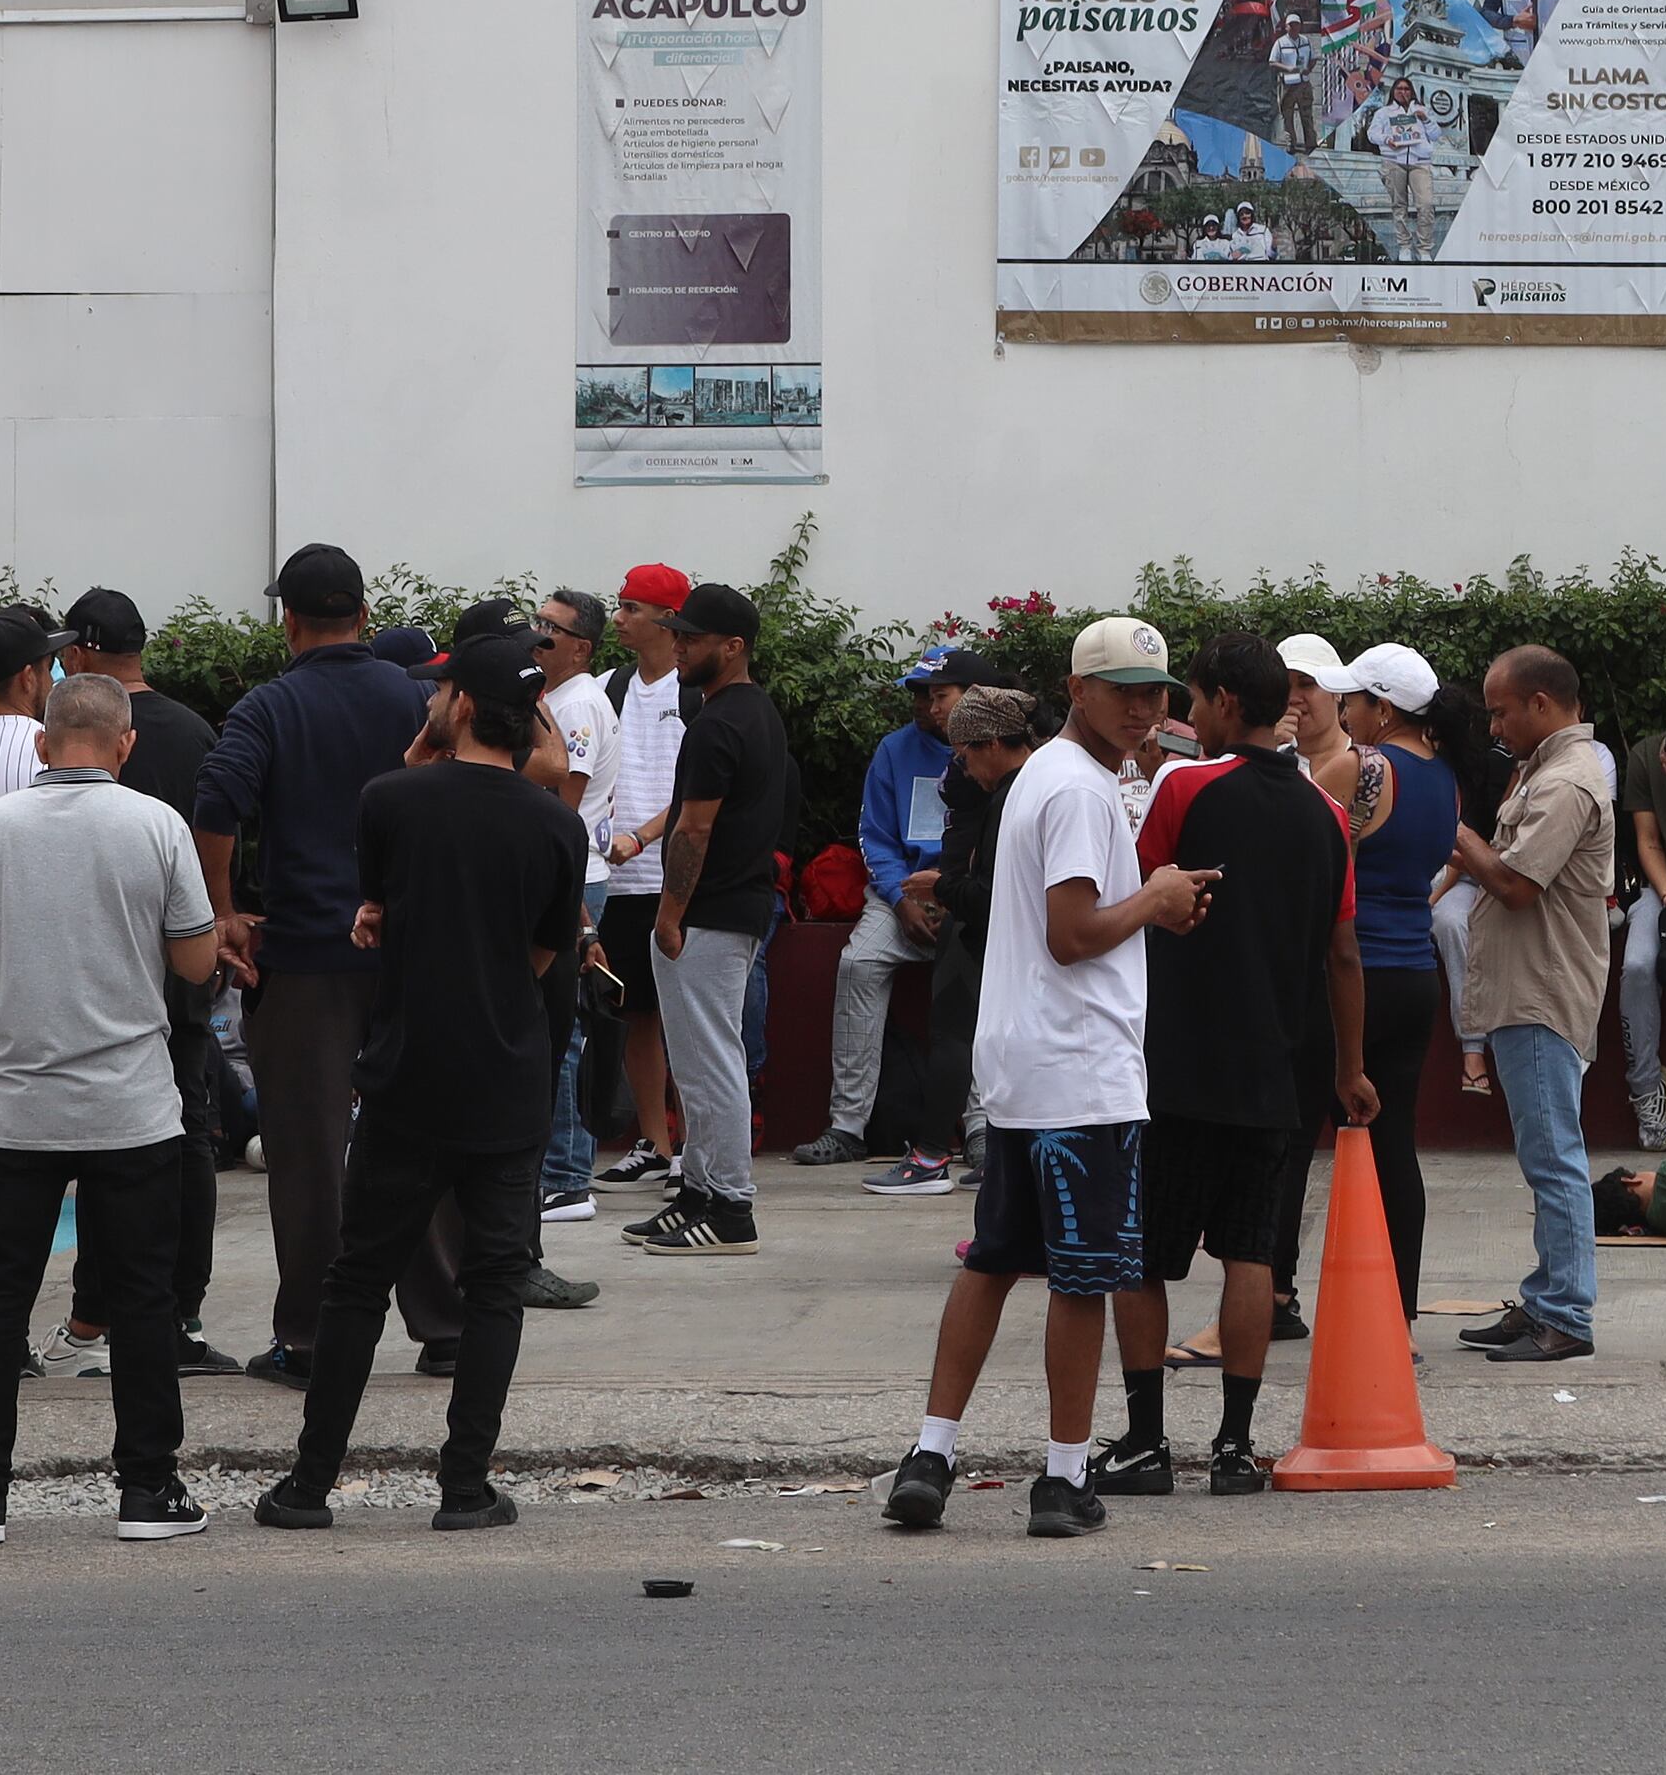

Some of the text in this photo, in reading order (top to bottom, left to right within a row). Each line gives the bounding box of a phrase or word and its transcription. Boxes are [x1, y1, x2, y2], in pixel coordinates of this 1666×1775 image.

[1607, 5, 1620, 14] de
[1015, 0, 1200, 43] paisanos
[1561, 22, 1583, 32] para
[1585, 20, 1629, 30] Trámites
[1632, 22, 1638, 32] y
[649, 30, 722, 48] aportación
[1043, 61, 1135, 76] ¿PAISANO,
[1568, 67, 1650, 86] LLAMA
[1008, 80, 1173, 93] NECESITAS AYUDA?
[633, 98, 727, 108] PUEDES DONAR:
[1546, 92, 1584, 111] SIN
[623, 117, 671, 126] Alimentos
[687, 117, 746, 127] perecederos
[623, 129, 709, 138] Agua embotellada
[1517, 134, 1562, 145] DESDE
[1565, 134, 1627, 145] ESTADOS
[668, 139, 679, 148] de
[681, 139, 716, 150] higiene
[718, 138, 759, 149] personal
[623, 150, 669, 160] Utensilios
[1527, 153, 1535, 168] 1
[1541, 153, 1578, 168] 877
[1583, 153, 1615, 168] 210
[668, 161, 679, 170] de
[681, 161, 721, 172] limpieza
[722, 161, 744, 171] para
[745, 159, 754, 169] el
[623, 173, 668, 182] Sandalias
[1549, 178, 1650, 191] DESDE MÉXICO
[1532, 199, 1664, 215] 800 201 8542
[628, 230, 663, 239] CENTRO
[665, 230, 676, 238] DE
[1177, 271, 1333, 293] GOBERNACIÓN
[1500, 280, 1552, 292] HÉROES
[628, 287, 672, 295] HORARIOS
[1500, 290, 1567, 305] paisanos
[1318, 315, 1448, 330] gob.mx/heroespaisanos
[645, 455, 719, 467] GOBERNACIÓN
